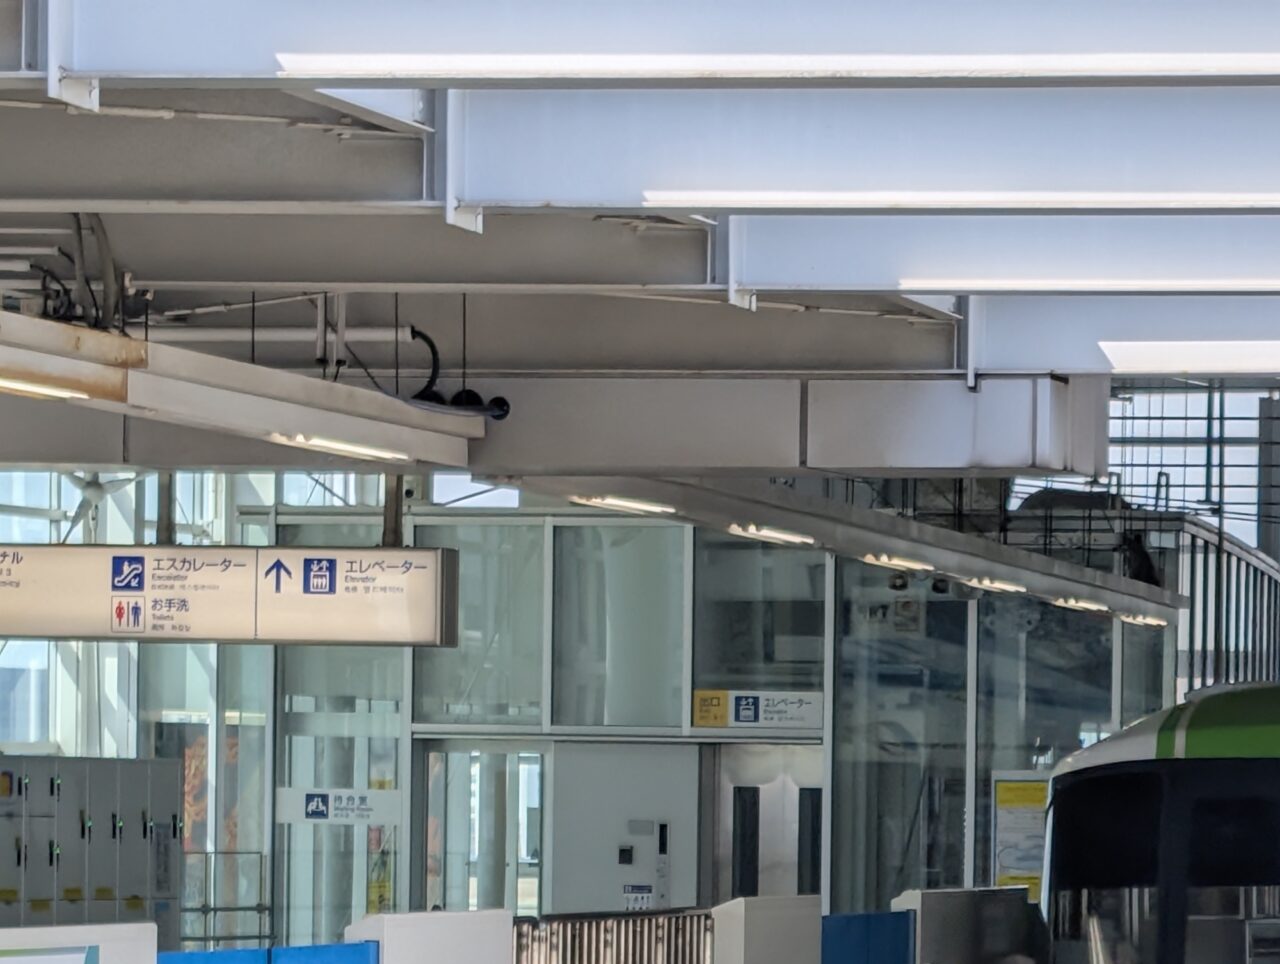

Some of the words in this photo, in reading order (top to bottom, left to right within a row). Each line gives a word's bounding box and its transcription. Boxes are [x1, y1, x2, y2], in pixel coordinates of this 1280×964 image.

[152, 557, 247, 573] エスカレーター
[345, 559, 428, 575] エレベーター
[151, 598, 190, 613] お手洗
[764, 698, 812, 709] エレベーター
